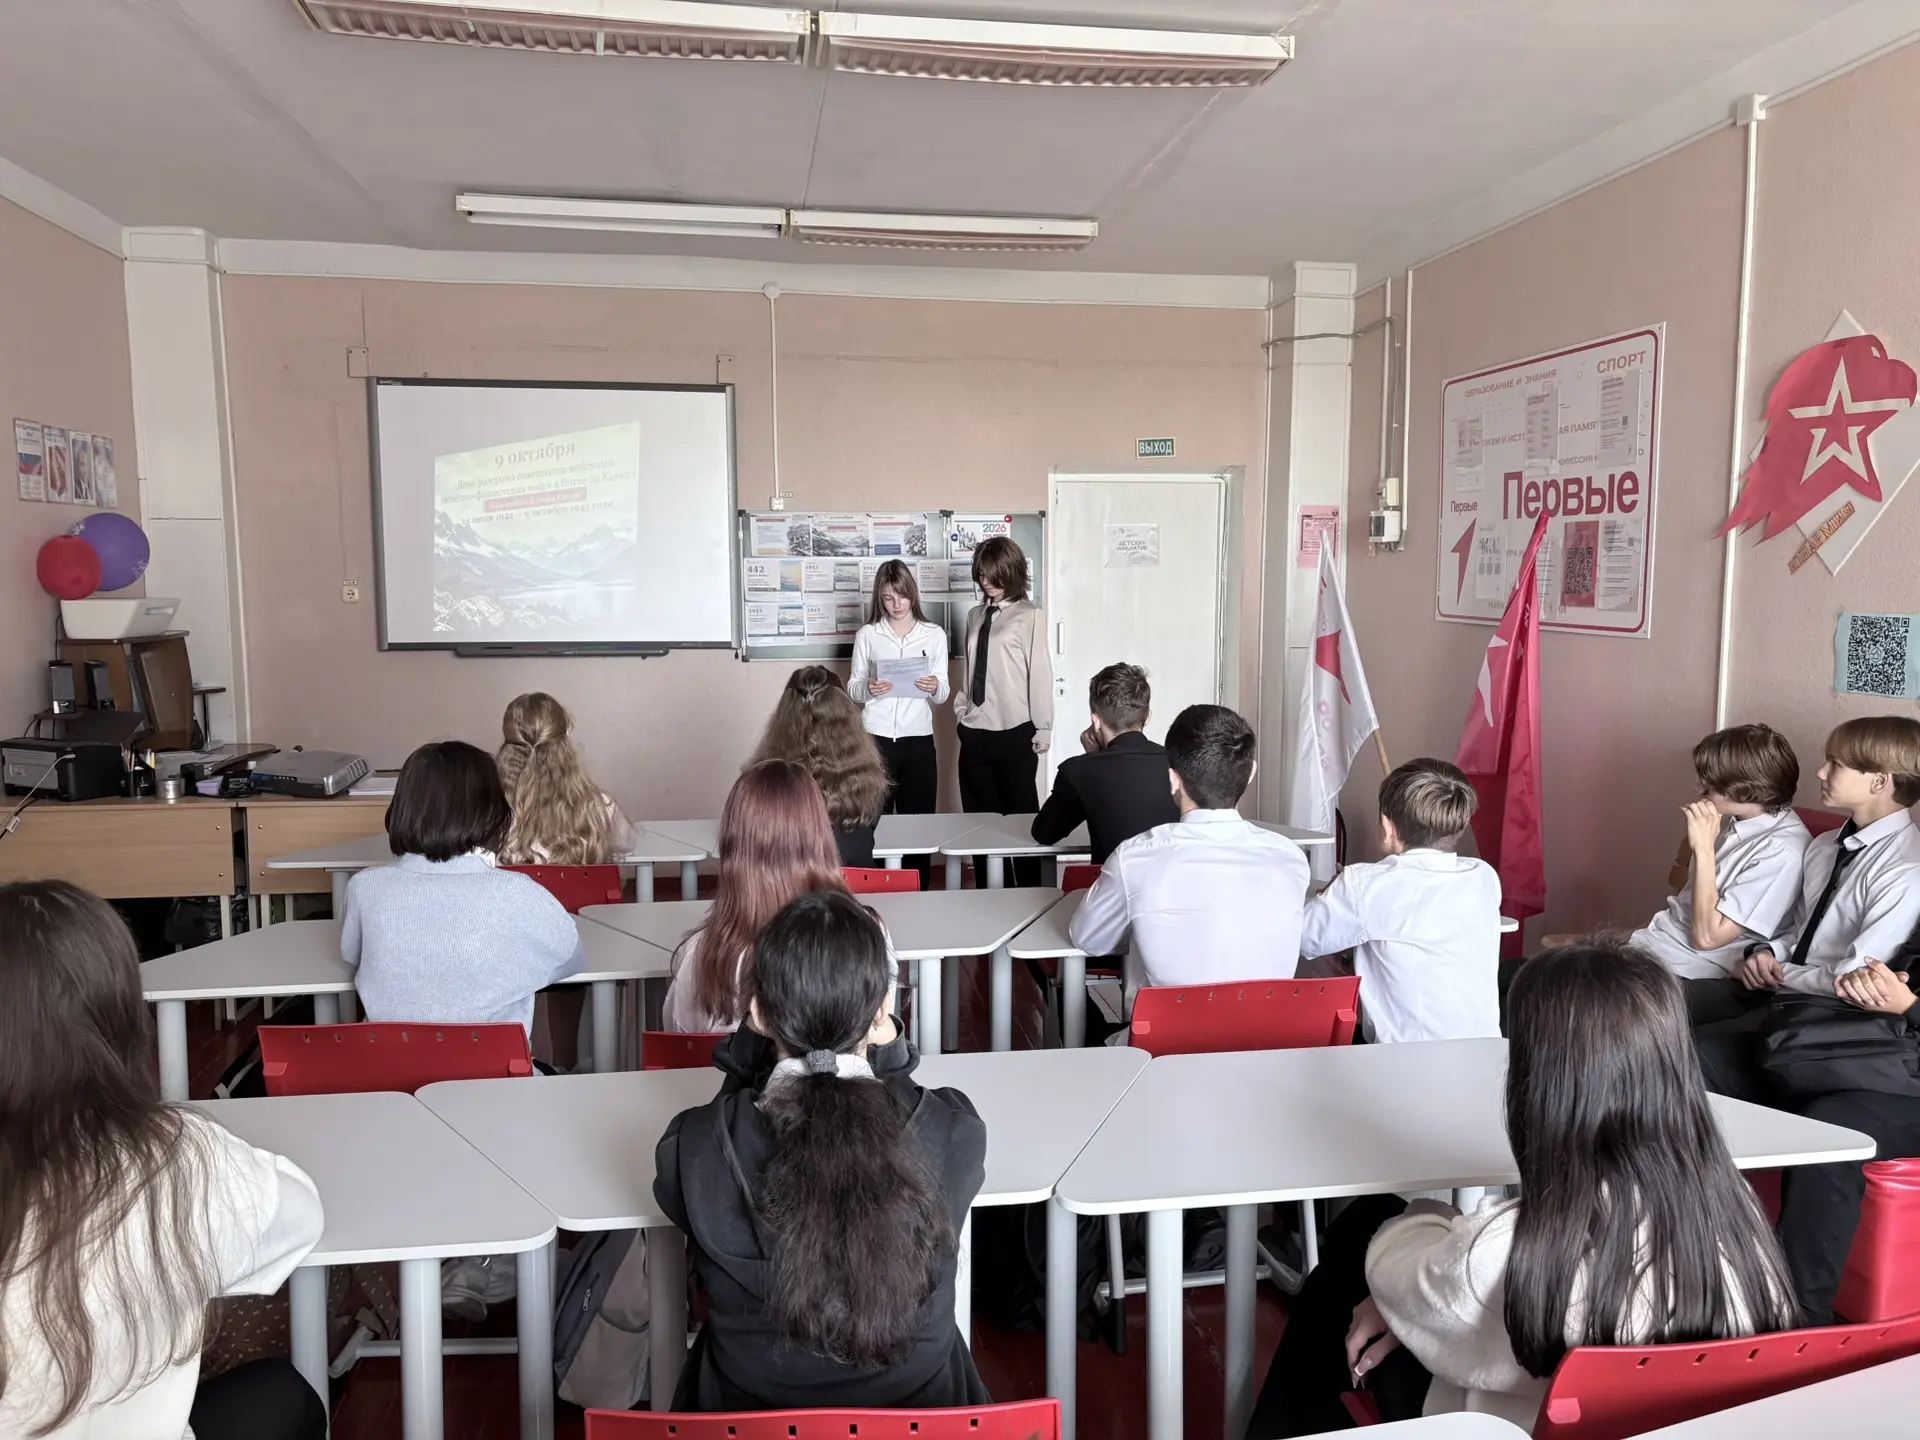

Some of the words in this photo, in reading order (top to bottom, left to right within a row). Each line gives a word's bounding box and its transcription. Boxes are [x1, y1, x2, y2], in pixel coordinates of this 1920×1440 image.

[1597, 351, 1646, 373] СПОРТ
[1465, 379, 1514, 398] ОБРАЗОВАНИЕ
[1524, 369, 1556, 384] ЗНАНИЯ
[1570, 421, 1598, 433] ПАМЯ
[495, 454, 504, 469] 9
[508, 442, 575, 464] октября
[1139, 441, 1172, 455] ВЫХОД
[1503, 470, 1639, 520] Первые
[1450, 500, 1477, 515] Первые
[982, 523, 1007, 533] 2026
[747, 565, 765, 573] 442
